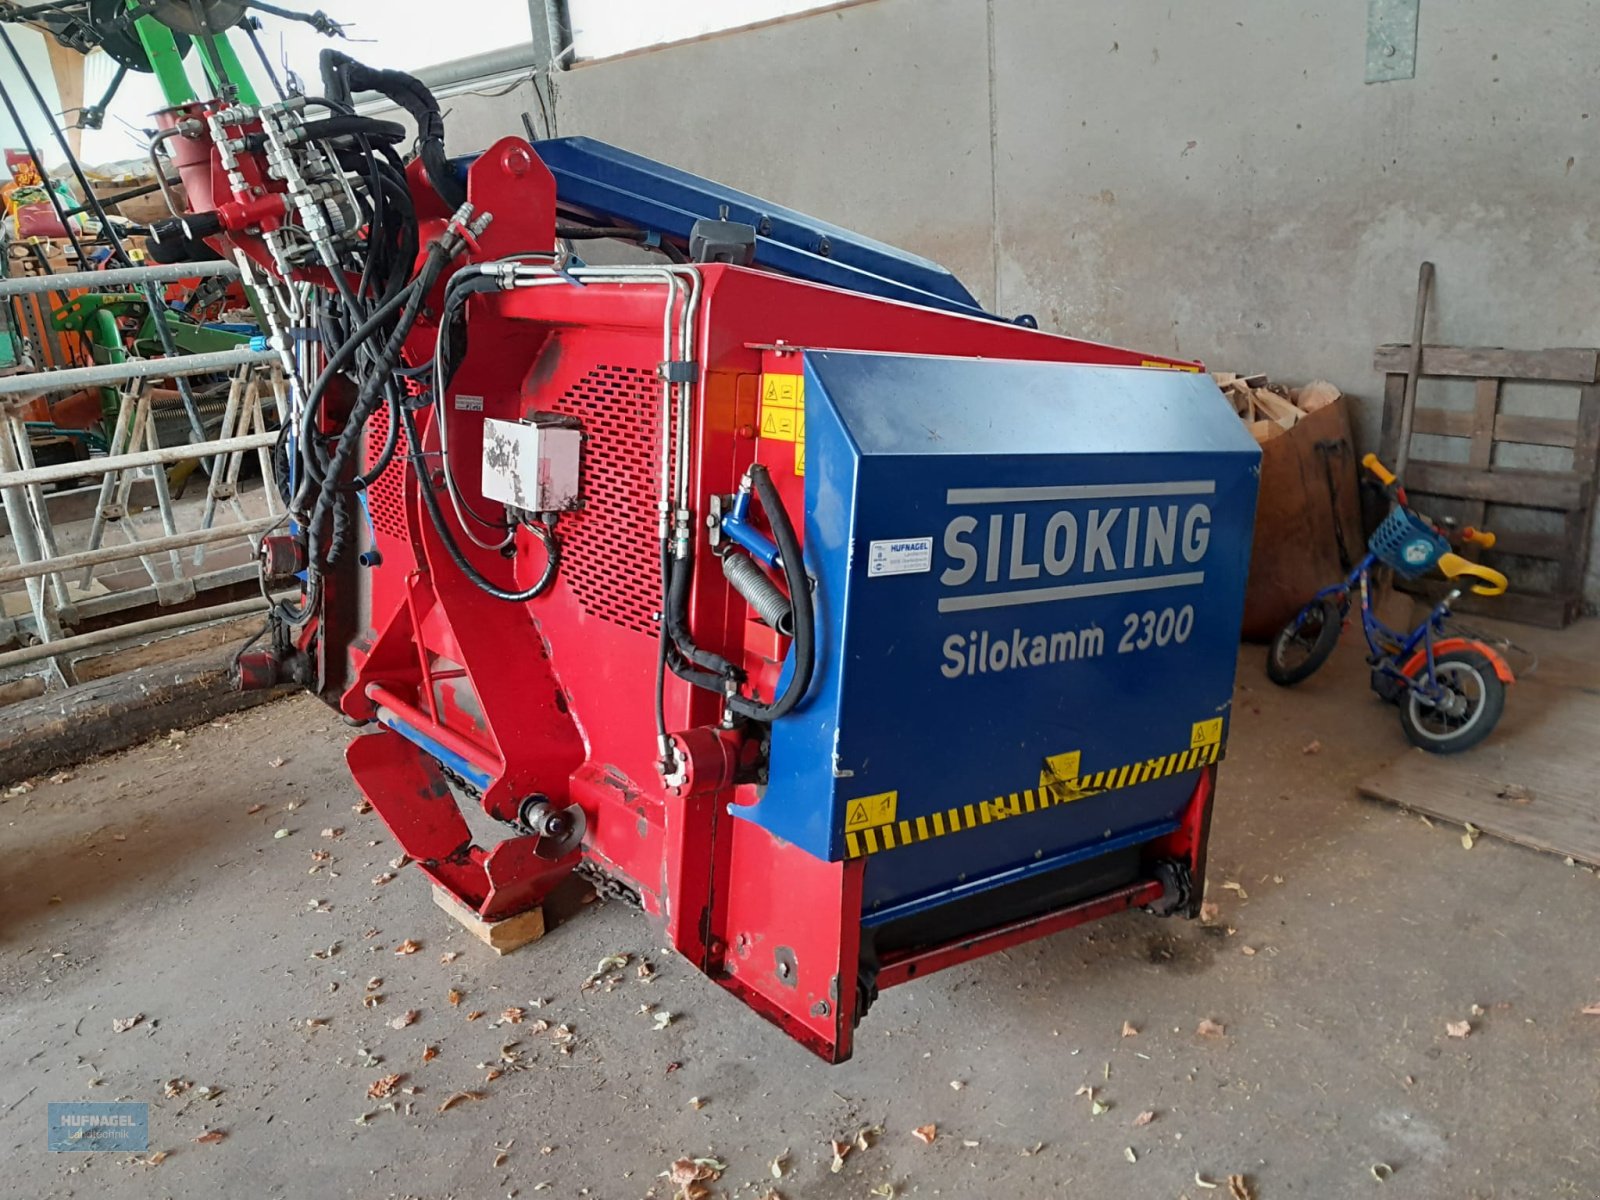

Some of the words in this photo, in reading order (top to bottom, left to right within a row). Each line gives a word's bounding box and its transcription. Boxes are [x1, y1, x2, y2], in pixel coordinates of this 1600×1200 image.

[890, 542, 928, 552] HUFNAGEL
[940, 504, 1211, 586] SILOKING
[941, 628, 1104, 678] Silokamm
[1118, 604, 1194, 653] 2300
